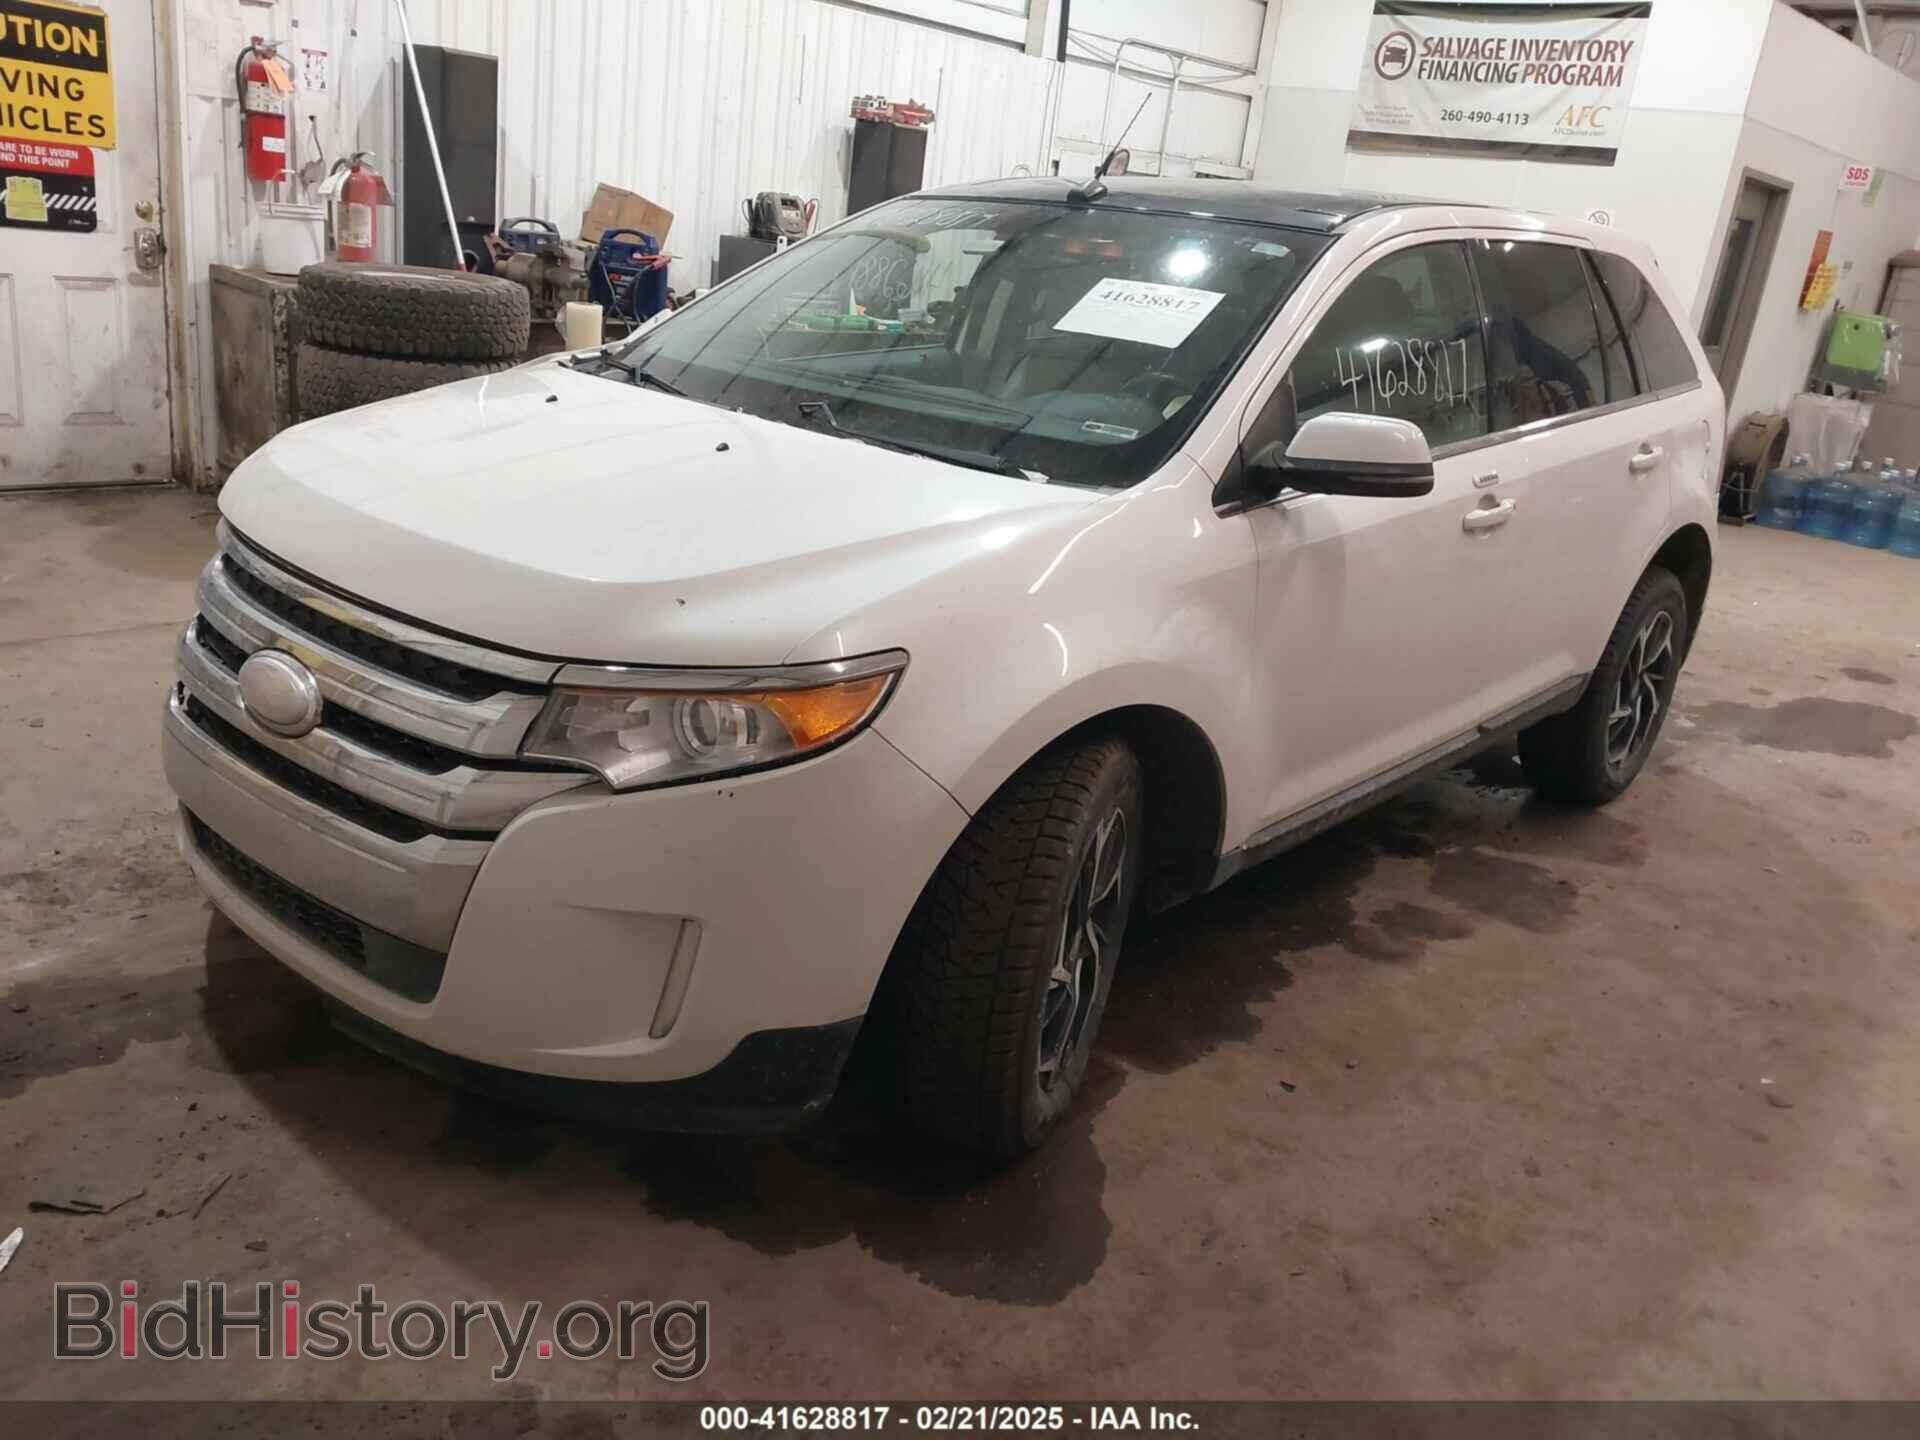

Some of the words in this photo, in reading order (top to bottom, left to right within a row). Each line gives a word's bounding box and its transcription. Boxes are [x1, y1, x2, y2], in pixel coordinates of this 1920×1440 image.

[1420, 36, 1507, 60] SALVAGE
[1510, 38, 1634, 63] INVENTORY
[1417, 59, 1520, 84] FINANCING
[1520, 63, 1624, 87] PROGRAM
[0, 102, 106, 138] ICLES
[1440, 108, 1529, 126] 260-490-4113
[1555, 104, 1612, 128] AFC
[18, 154, 40, 165] THIS
[41, 156, 70, 169] POINT
[19, 143, 33, 155] TO
[34, 145, 48, 156] BE
[48, 147, 79, 160] WORN
[1846, 167, 1870, 181] SDS
[1101, 289, 1200, 312] 41628817
[1335, 338, 1467, 413] 41628817
